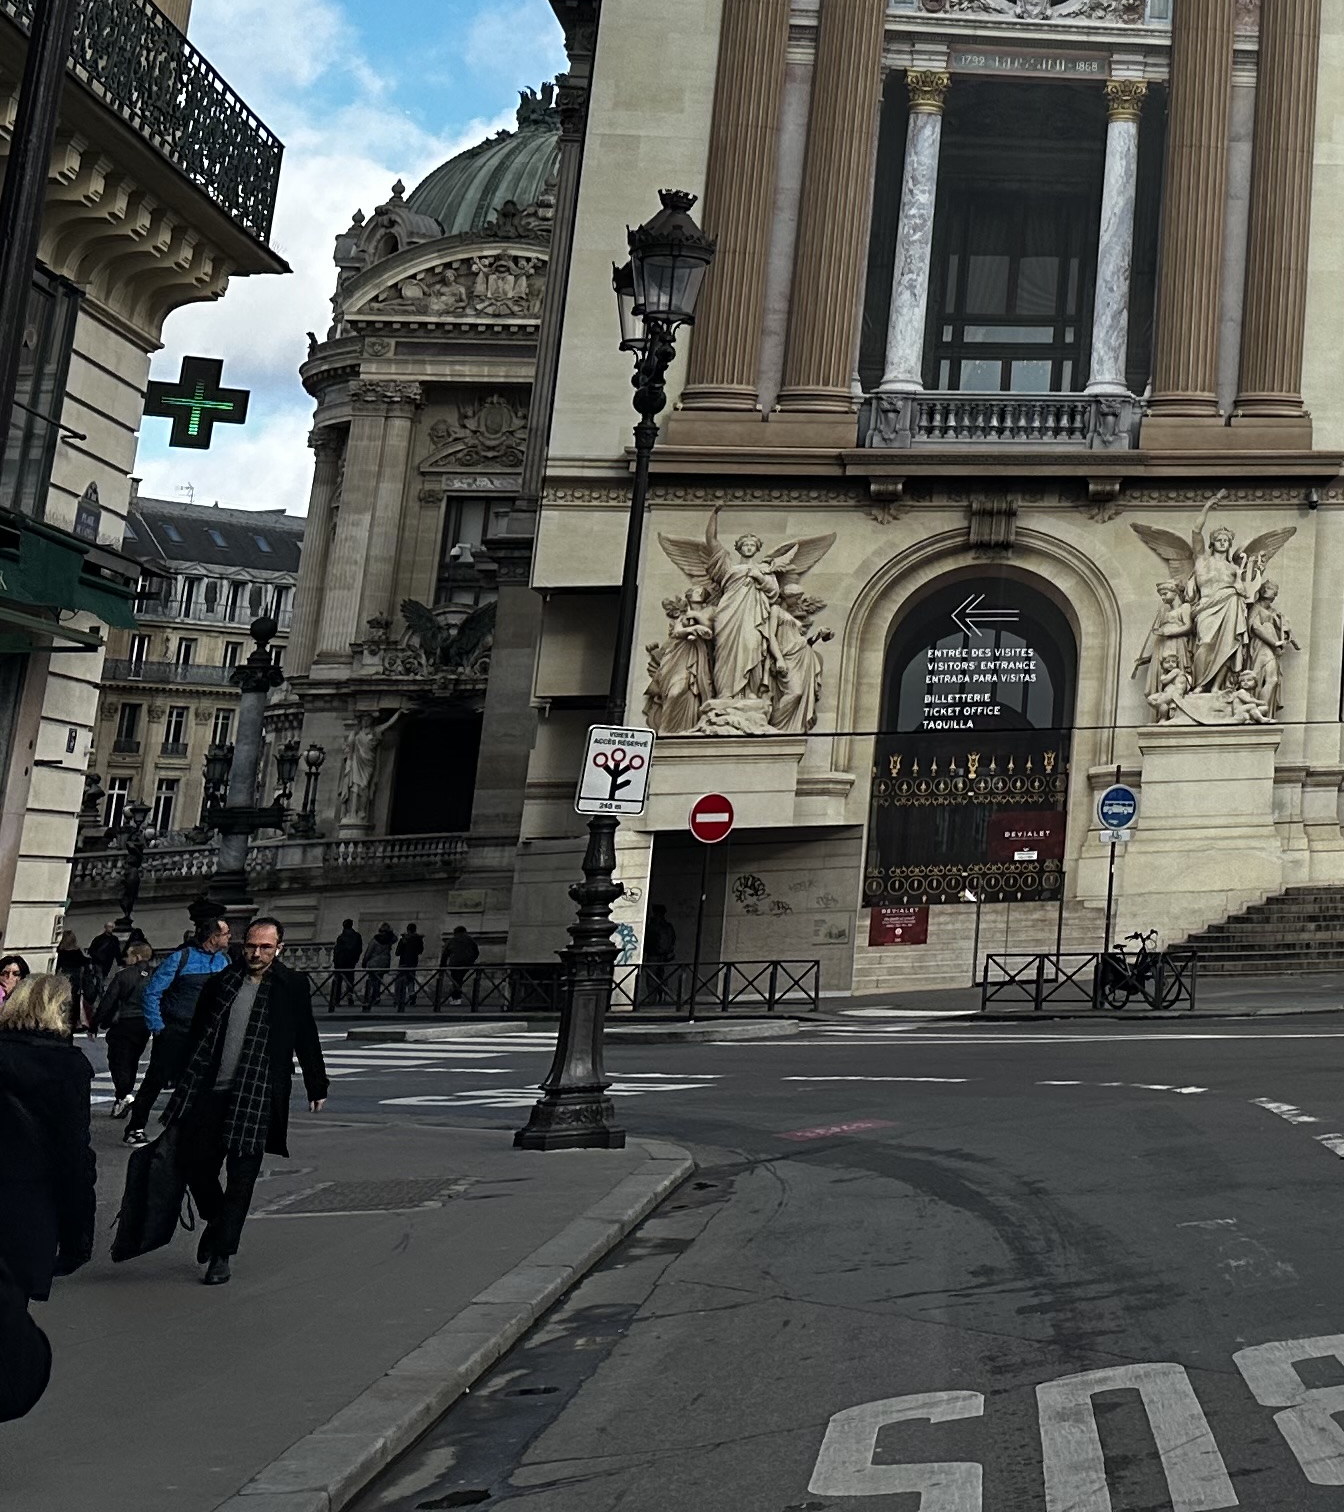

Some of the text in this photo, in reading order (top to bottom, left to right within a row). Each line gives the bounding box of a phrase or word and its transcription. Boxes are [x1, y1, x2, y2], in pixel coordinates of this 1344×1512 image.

[928, 647, 1034, 658] ENTRÉE DES VISITES
[981, 661, 1036, 670] ENTRANCE
[926, 674, 1036, 684] ENTRADA PARA VISITAS
[924, 694, 991, 703] BILLETTERIE
[924, 706, 1001, 716] TICKET OFFICE
[923, 720, 974, 729] TAQUILLA
[1004, 830, 1051, 838] DEVIALET
